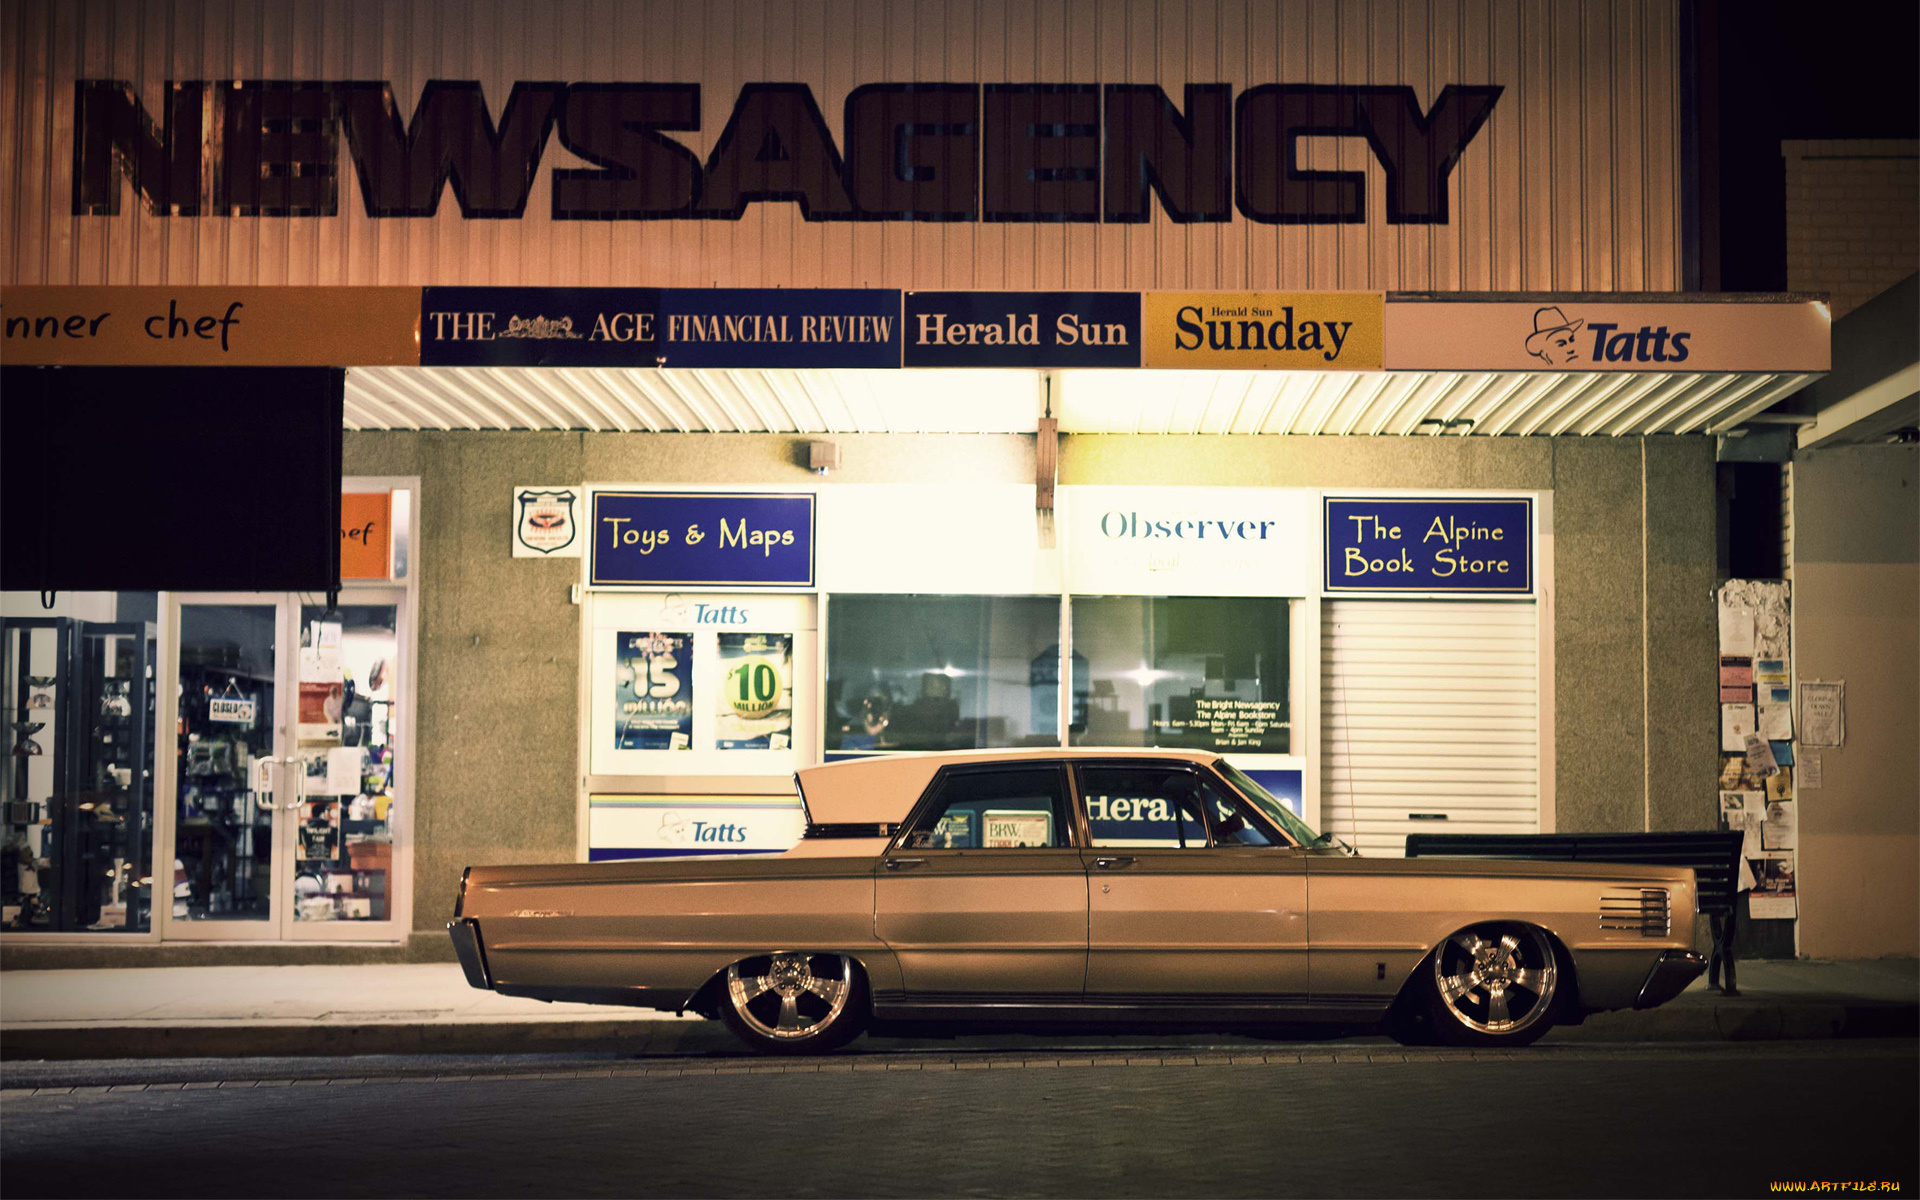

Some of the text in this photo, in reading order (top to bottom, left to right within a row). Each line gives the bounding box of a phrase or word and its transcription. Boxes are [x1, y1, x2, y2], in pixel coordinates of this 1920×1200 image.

[71, 80, 1505, 225] NEWSAGENCY
[0, 299, 244, 352] nner chef
[1211, 306, 1273, 317] Herald Sun
[430, 312, 655, 342] THE AGE
[667, 314, 894, 343] FINANCIAL REVIEW
[916, 313, 1129, 346] Herald Sun
[1175, 306, 1353, 360] Sunday
[1586, 323, 1691, 362] Tatts
[603, 517, 795, 557] Toys & Maps
[1100, 510, 1276, 541] Observer
[1348, 515, 1505, 551] The Alpine
[1344, 547, 1509, 577] Book Store
[695, 604, 750, 625] Tatts
[213, 702, 238, 713] CLOSED
[733, 701, 775, 712] MILLION
[1196, 700, 1280, 711] The Bright Newsagency
[1196, 710, 1276, 720] The Alpine Bookstore
[1085, 796, 1194, 822] Hera
[692, 822, 747, 842] Tatts
